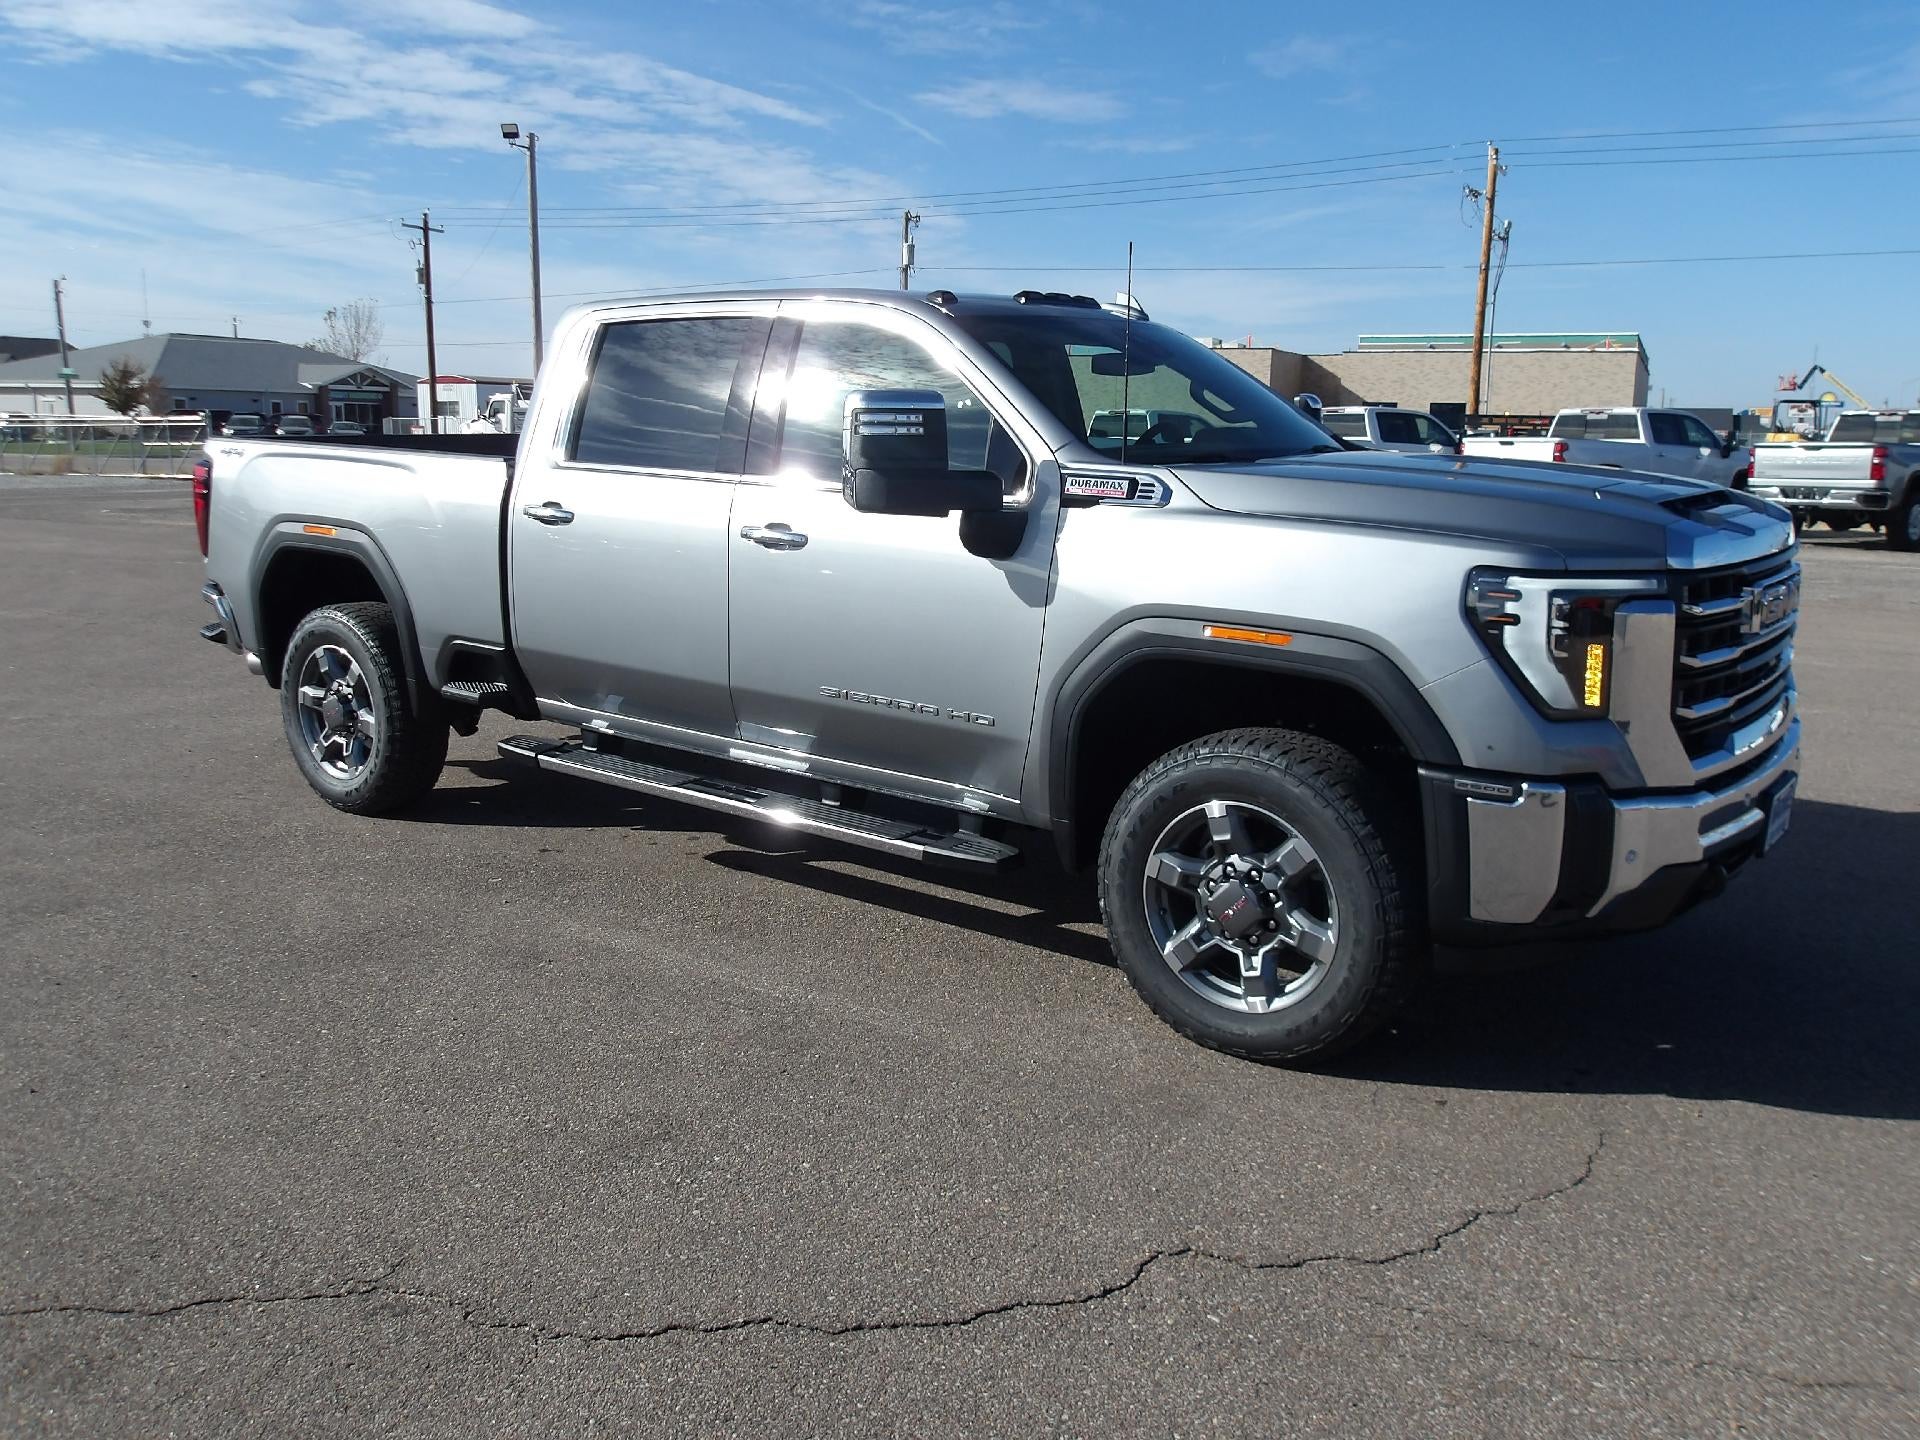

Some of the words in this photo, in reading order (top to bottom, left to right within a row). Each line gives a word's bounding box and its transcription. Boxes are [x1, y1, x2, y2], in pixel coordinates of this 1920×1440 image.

[1070, 478, 1125, 491] DURAMAX
[819, 685, 940, 717] SIERRA
[946, 707, 996, 728] HD
